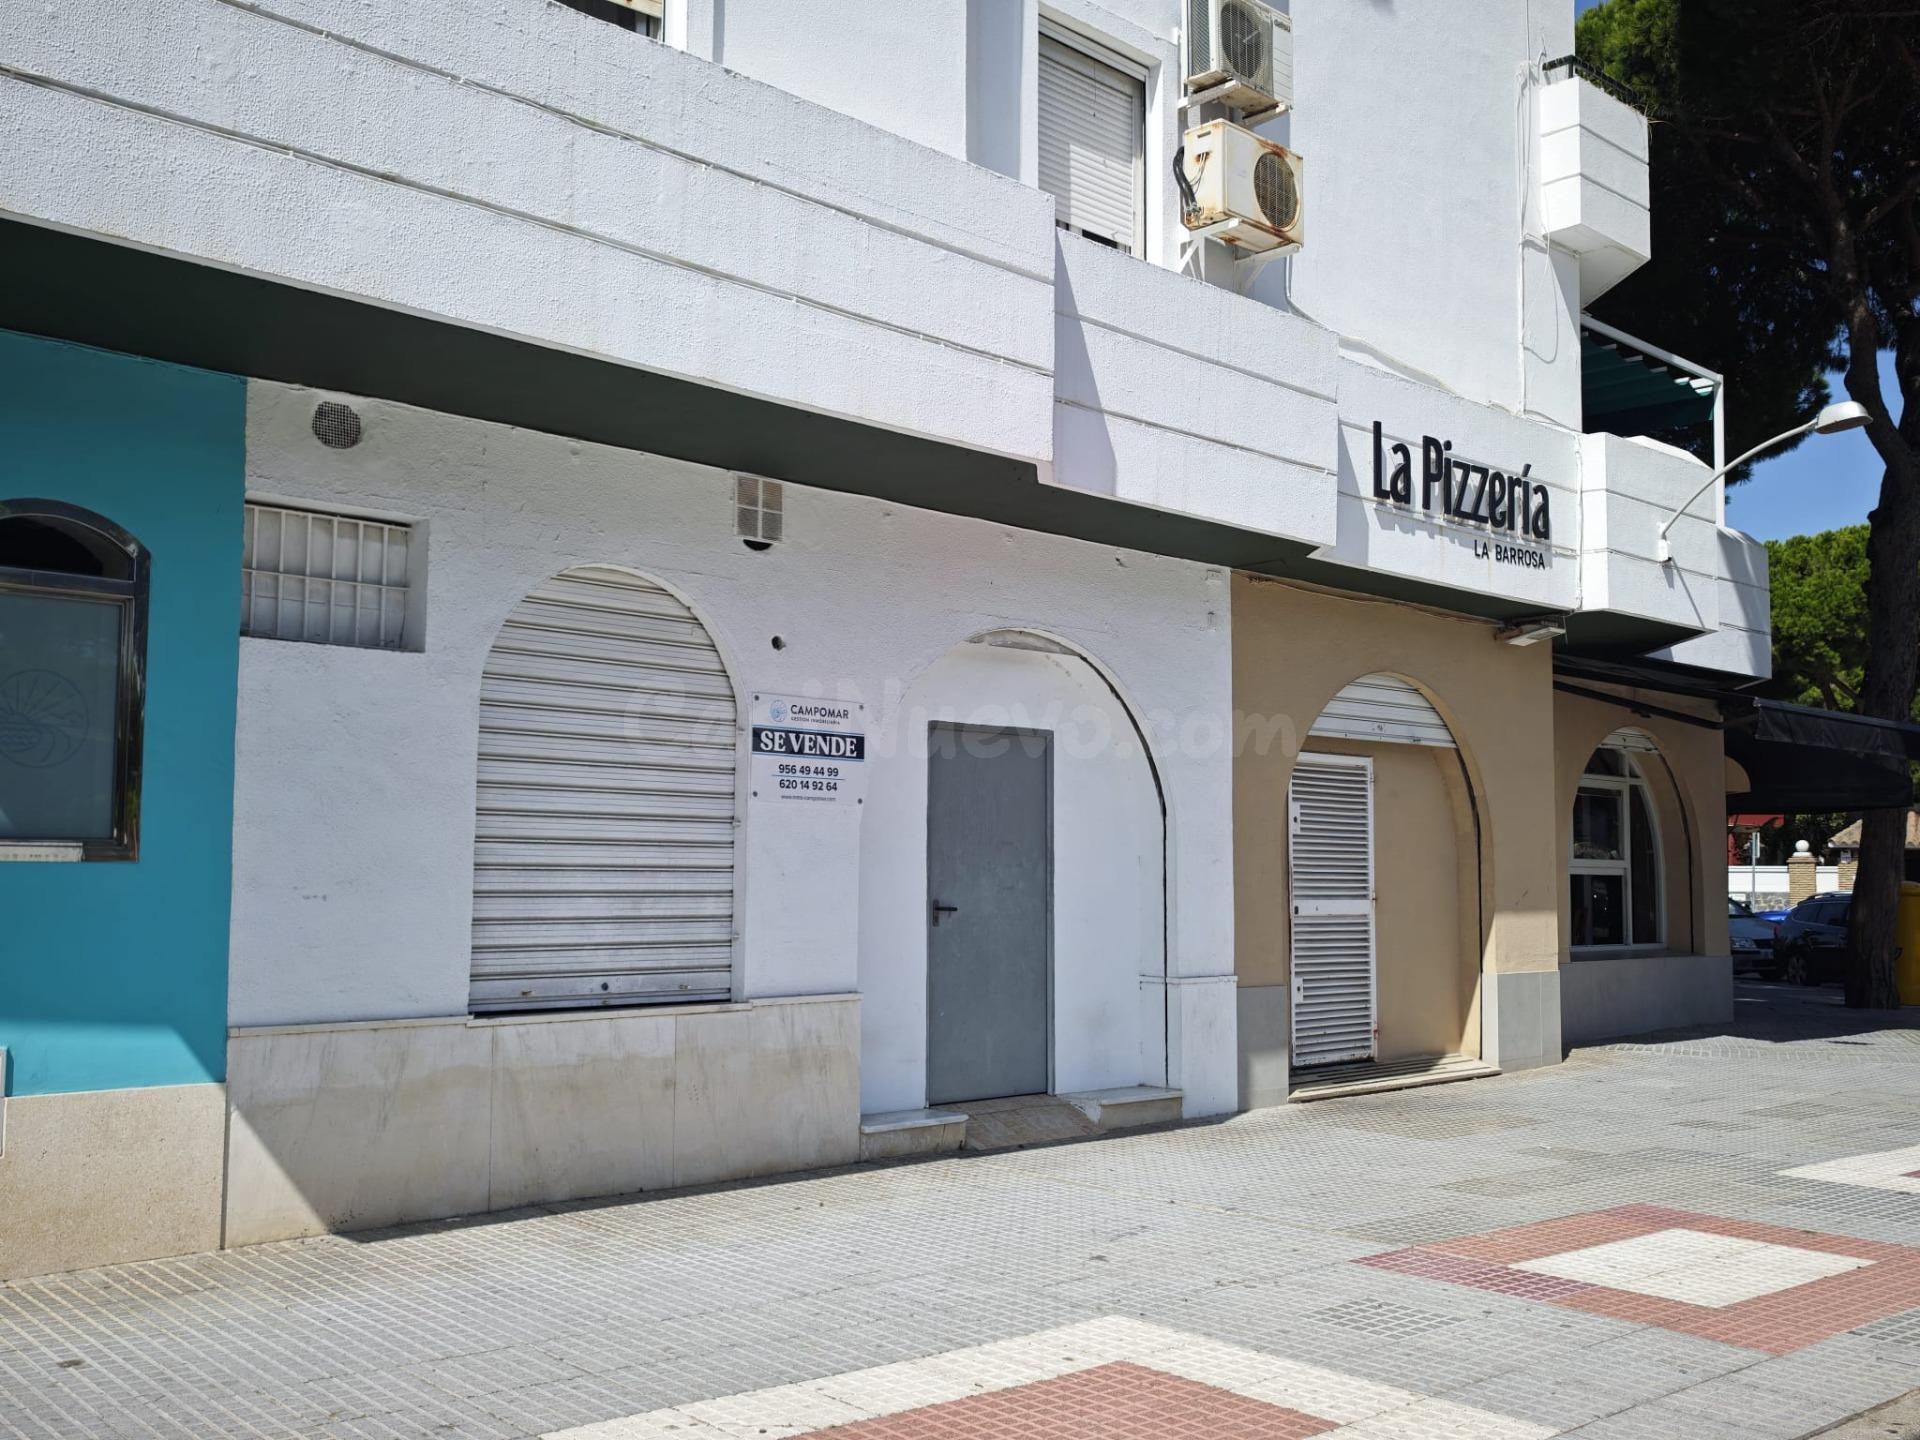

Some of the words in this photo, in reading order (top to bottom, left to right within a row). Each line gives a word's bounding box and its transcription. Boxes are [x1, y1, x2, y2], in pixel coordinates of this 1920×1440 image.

[1373, 421, 1411, 504] La
[1422, 435, 1550, 540] Pizzería
[1474, 539, 1490, 560] LA
[1495, 544, 1546, 569] BARROSA
[790, 704, 849, 719] CAMPOMAR
[760, 730, 786, 752] SE
[788, 732, 857, 758] VENDE
[778, 764, 797, 774] 956
[799, 765, 811, 775] 49
[813, 766, 825, 776] 44
[827, 767, 839, 777] 99
[779, 779, 798, 790] 620
[800, 780, 810, 790] 14
[812, 781, 824, 791] 92
[826, 782, 838, 792] 64
